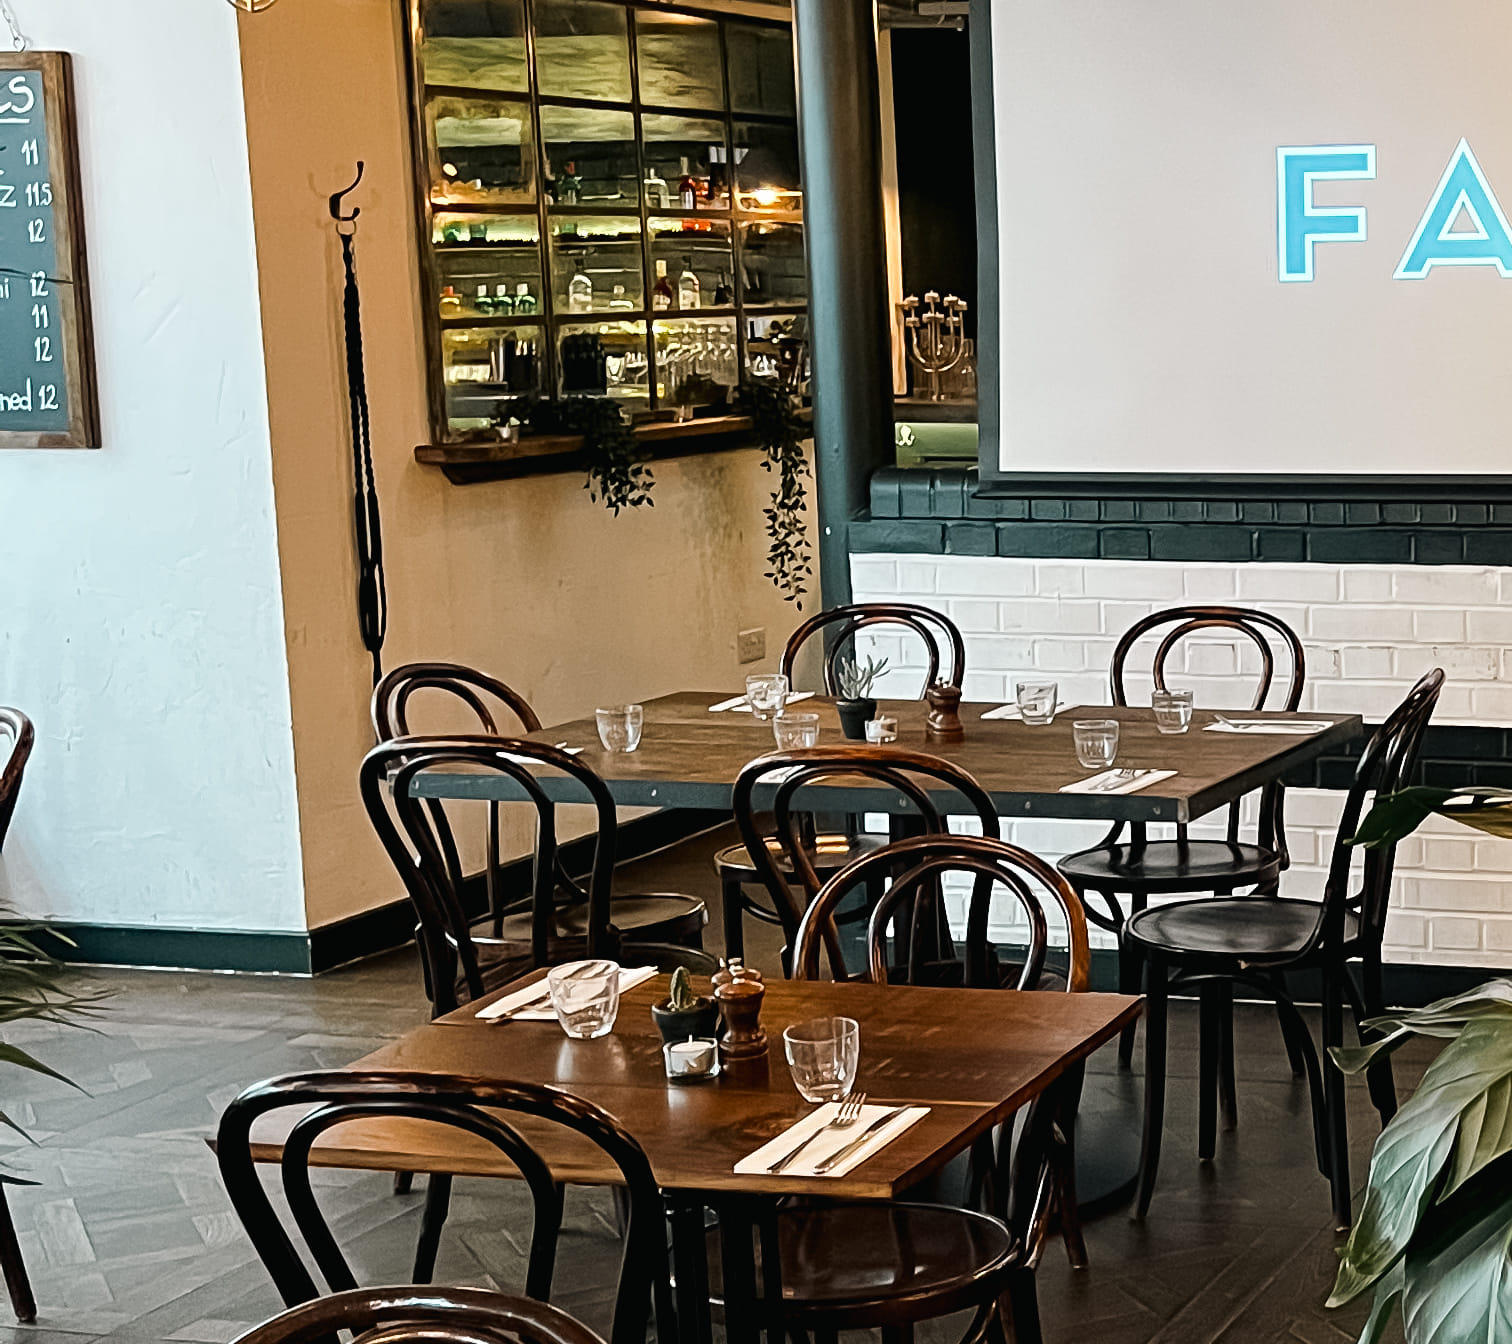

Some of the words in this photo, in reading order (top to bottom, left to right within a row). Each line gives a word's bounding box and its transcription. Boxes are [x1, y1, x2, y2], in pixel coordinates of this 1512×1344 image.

[21, 138, 39, 166] 11
[28, 218, 46, 243] 12
[29, 270, 49, 297] 12
[31, 303, 49, 329] 11
[34, 336, 53, 362] 12
[38, 384, 59, 410] 12
